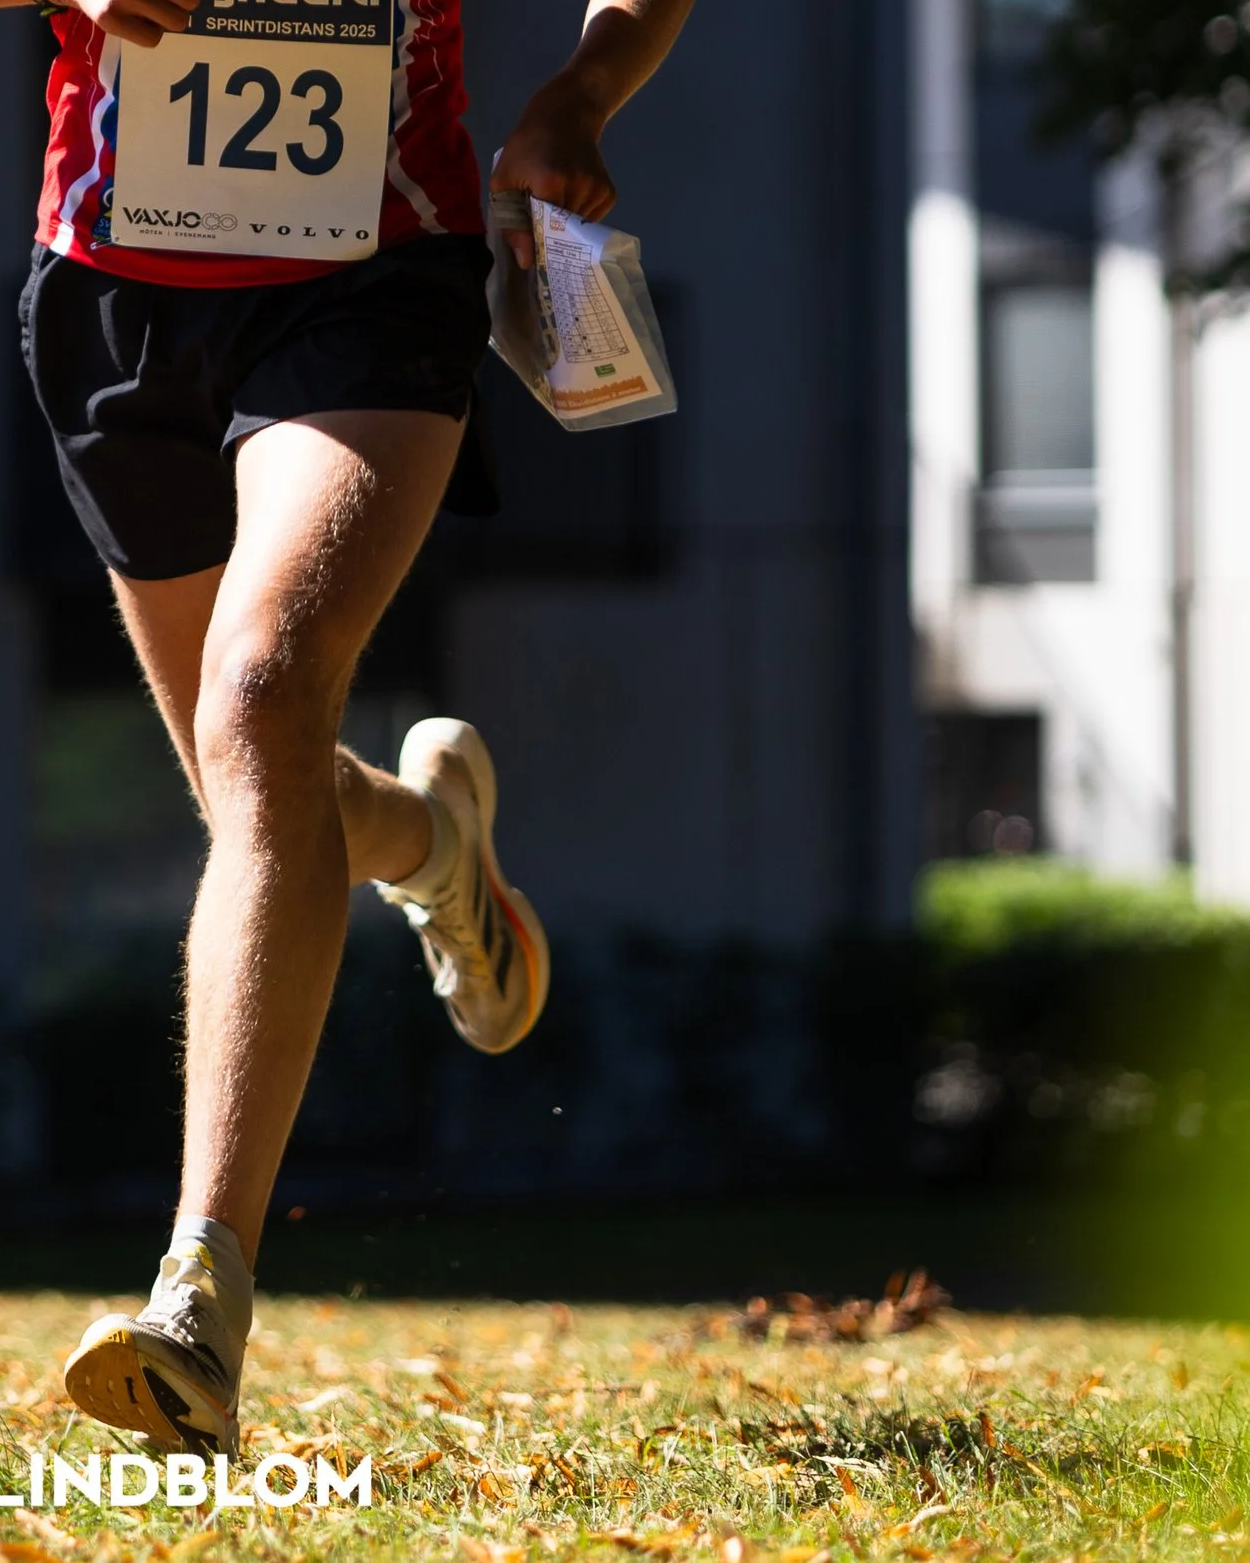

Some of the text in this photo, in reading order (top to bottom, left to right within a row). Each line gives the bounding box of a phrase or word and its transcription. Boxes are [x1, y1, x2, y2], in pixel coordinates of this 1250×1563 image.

[206, 17, 335, 36] SPRINTDISTANS
[340, 23, 377, 38] 2025
[169, 61, 345, 177] 123
[248, 222, 370, 241] VOLVO
